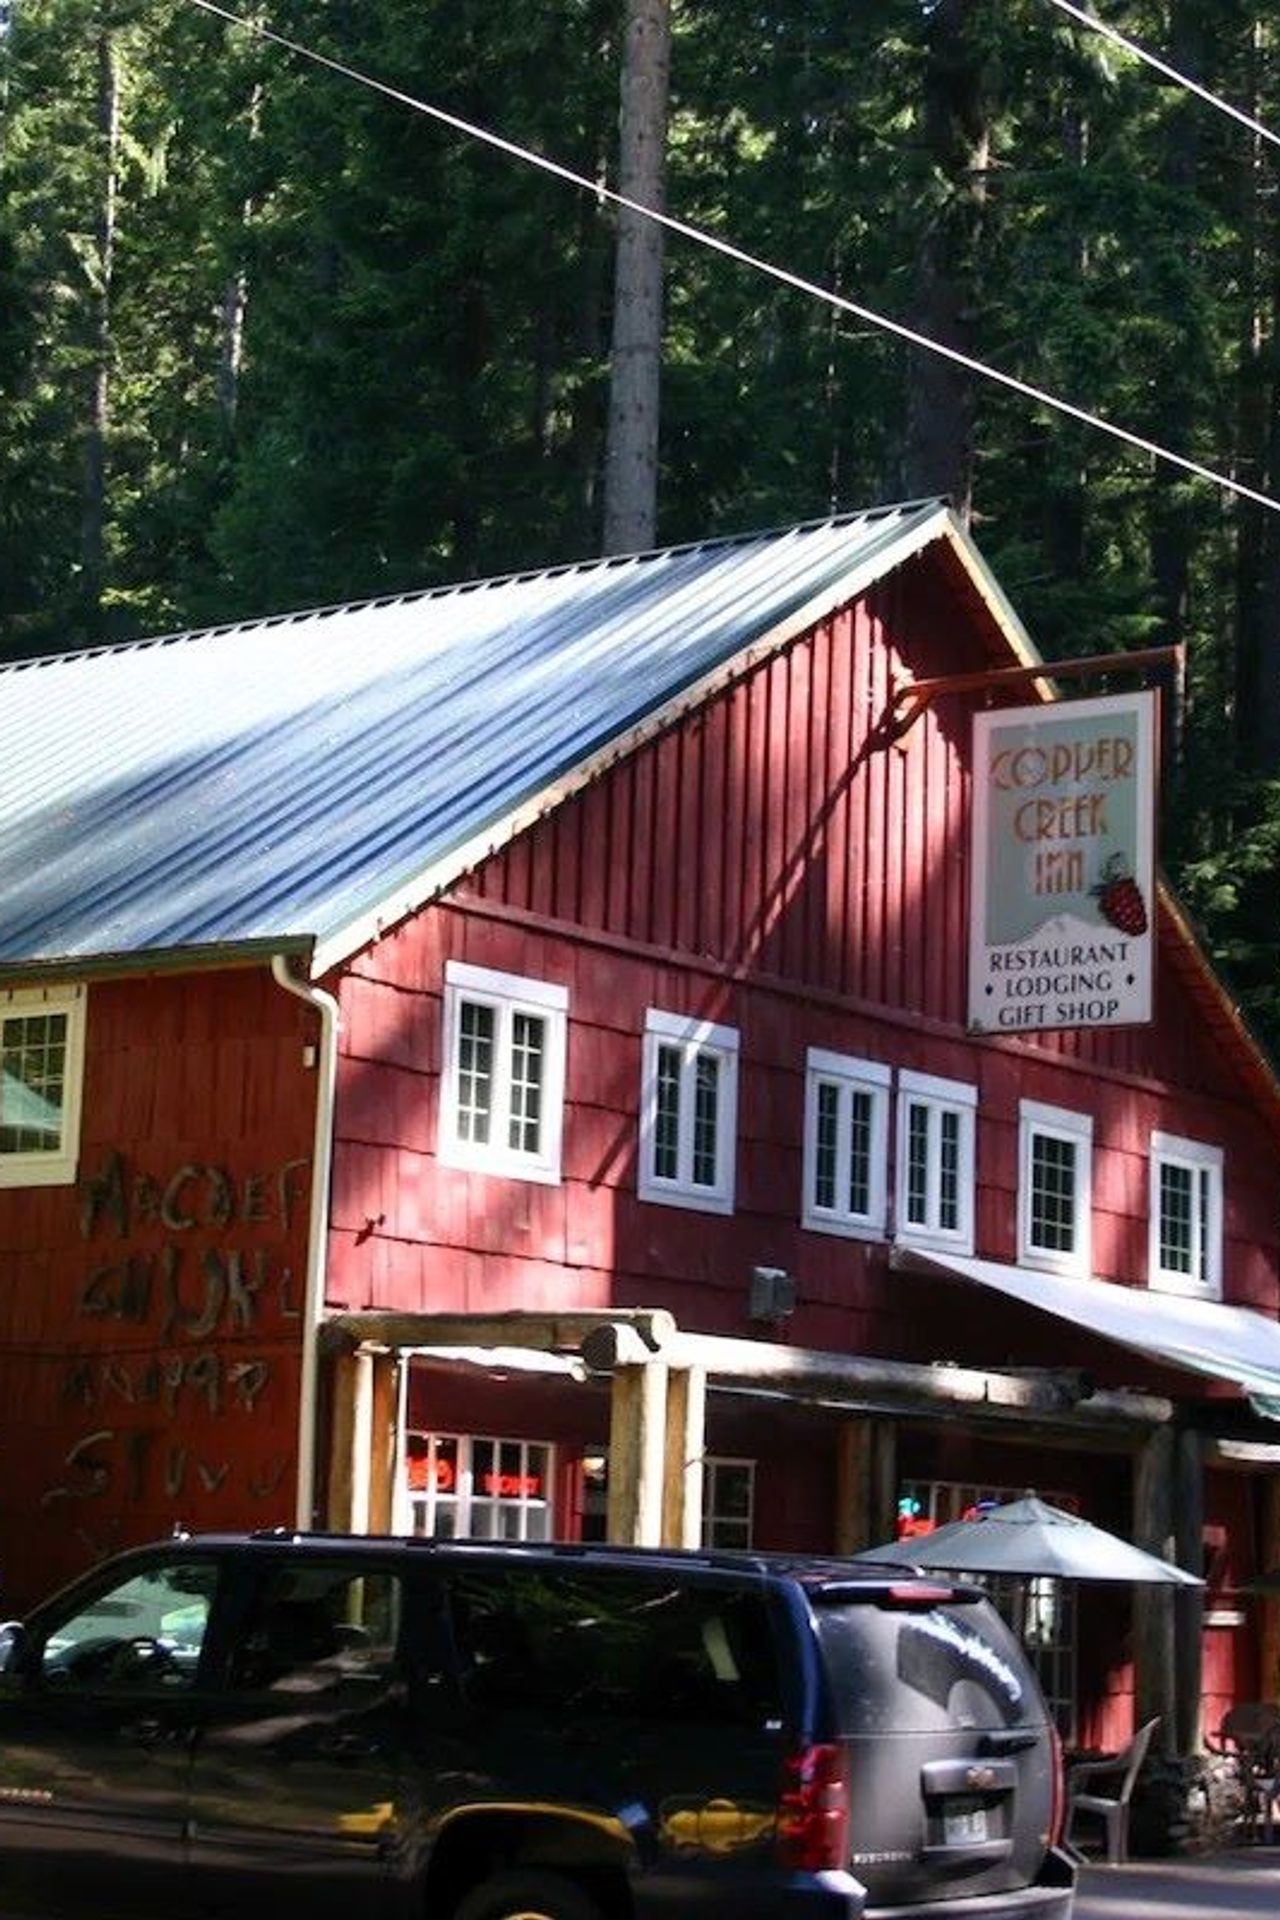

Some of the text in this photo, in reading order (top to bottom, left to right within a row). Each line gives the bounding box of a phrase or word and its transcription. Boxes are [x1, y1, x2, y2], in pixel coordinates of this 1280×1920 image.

[989, 739, 1133, 790] COPPER
[1013, 794, 1108, 842] CREEK
[1035, 850, 1083, 895] INN
[989, 942, 1128, 973] RESTAURANT
[1005, 970, 1112, 998] LODGING
[998, 999, 1120, 1026] GIFT SHOP
